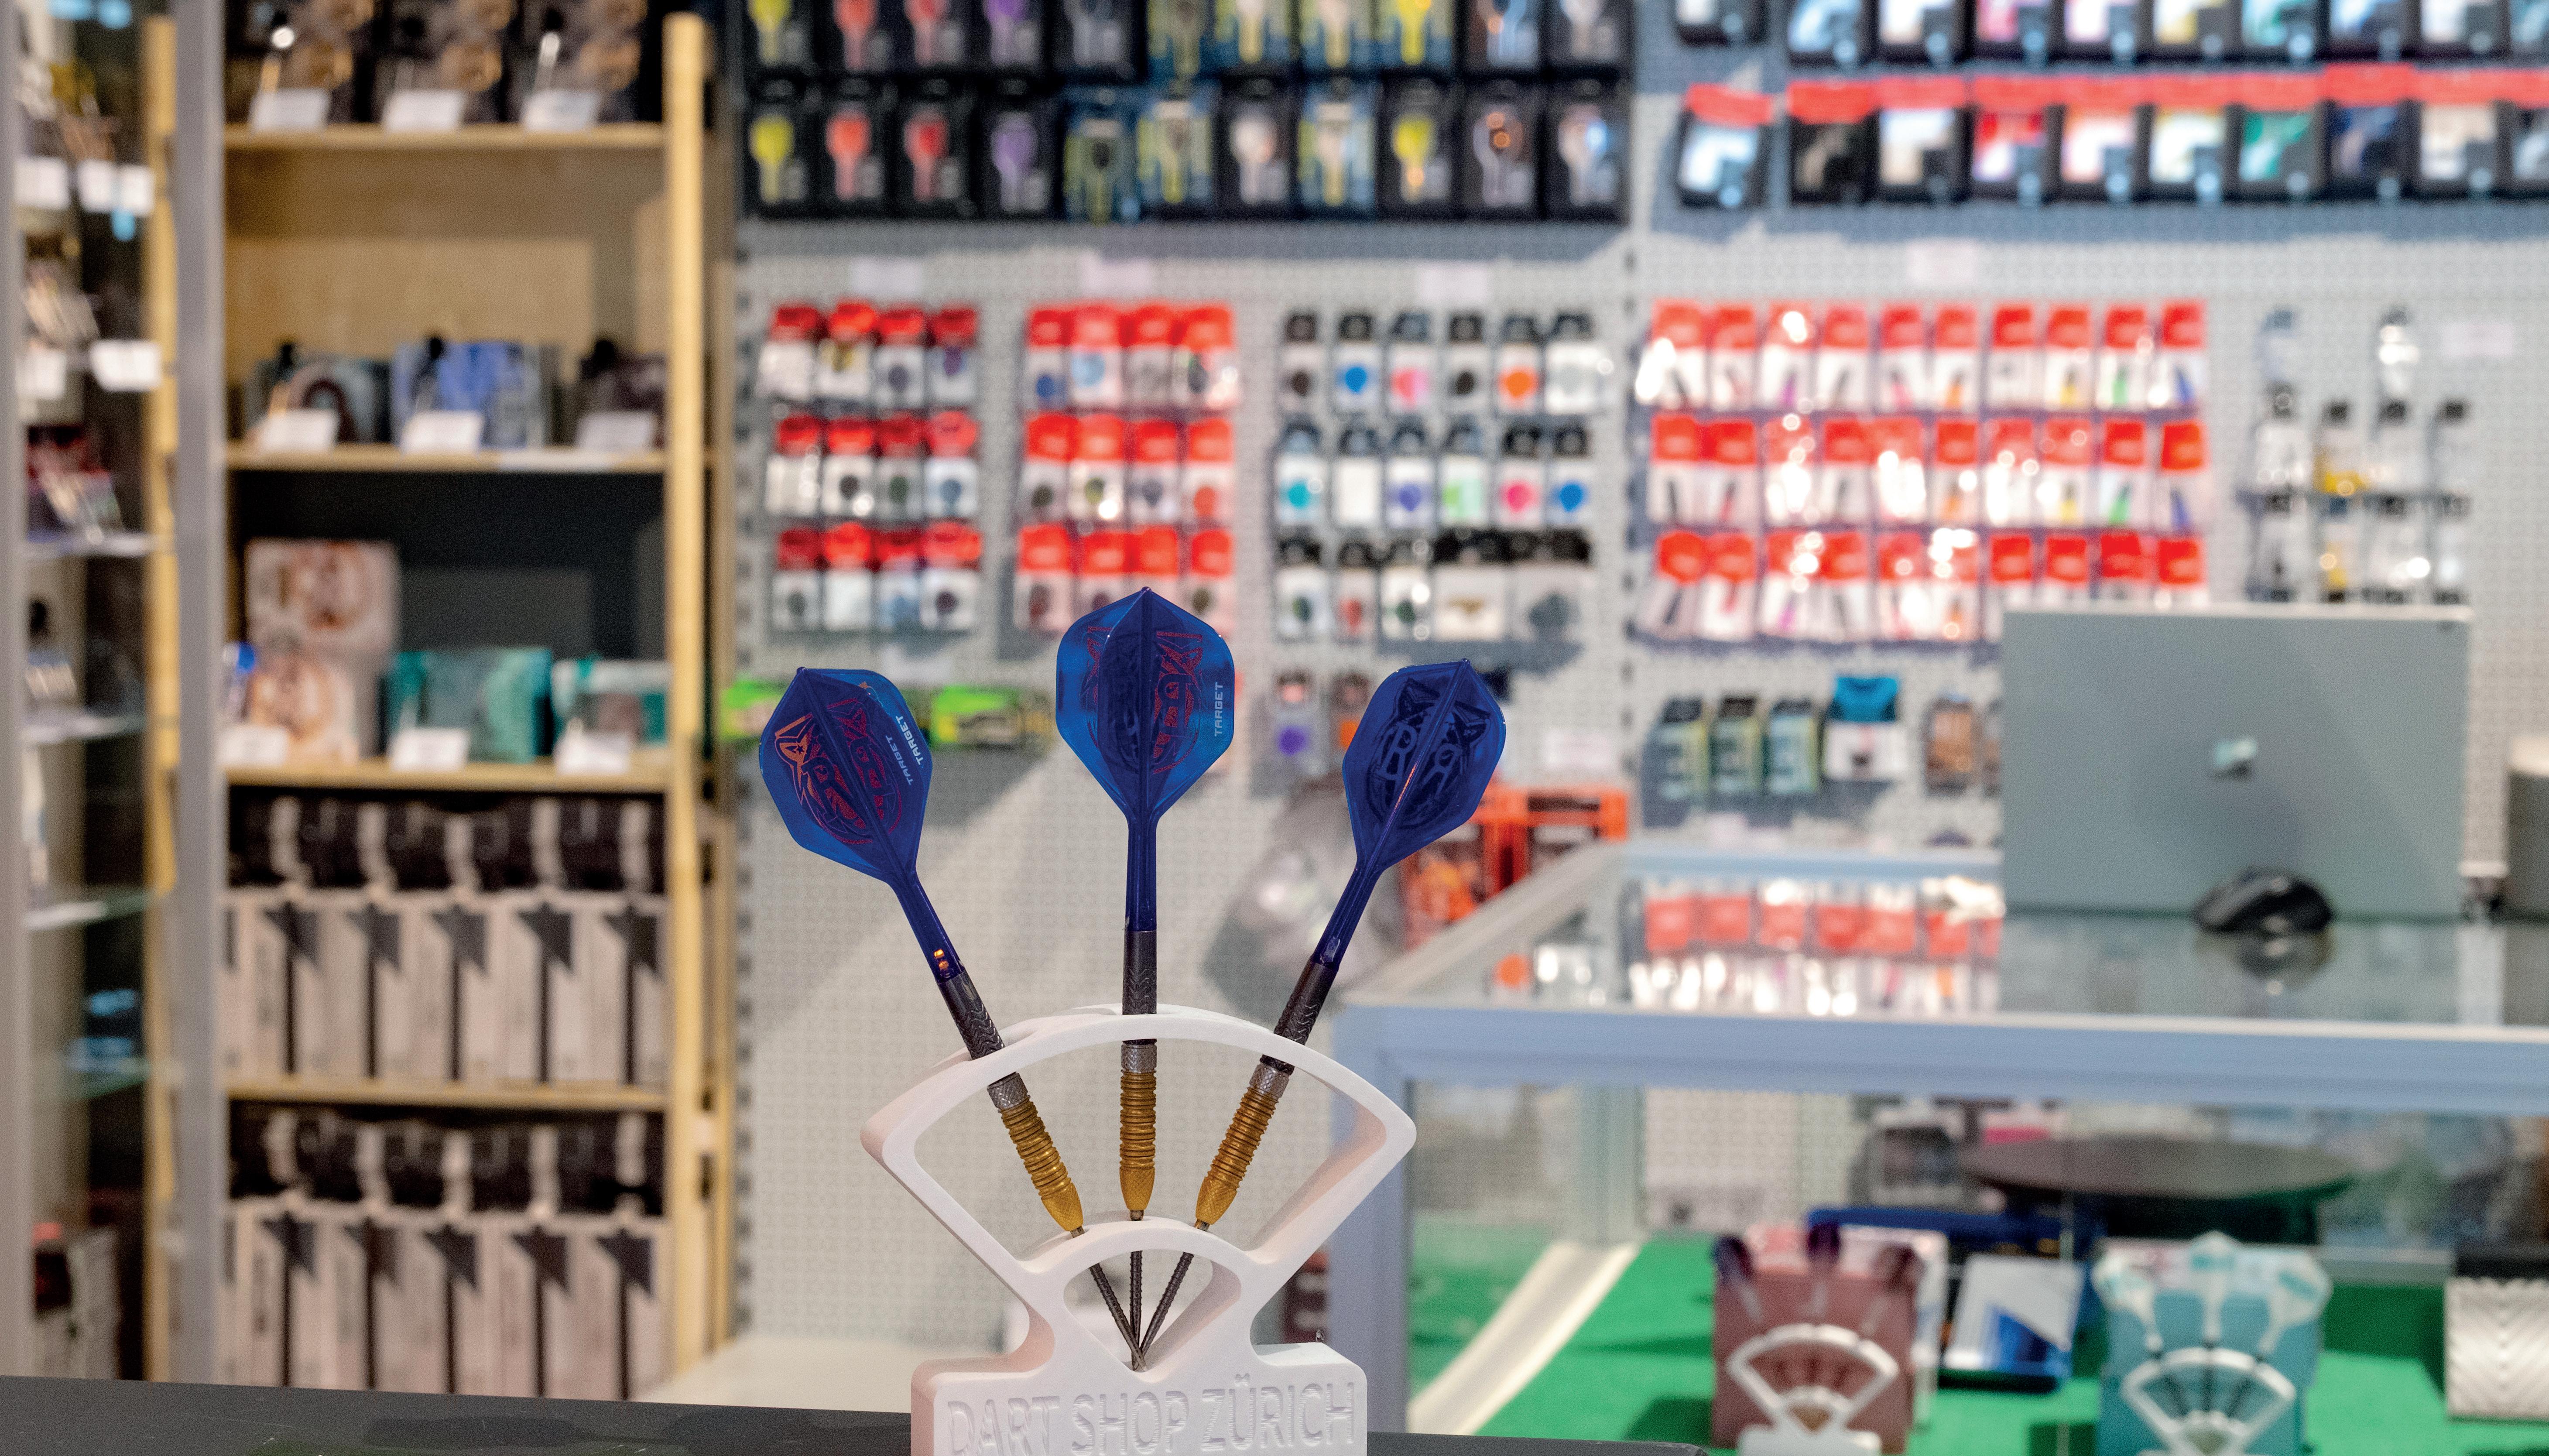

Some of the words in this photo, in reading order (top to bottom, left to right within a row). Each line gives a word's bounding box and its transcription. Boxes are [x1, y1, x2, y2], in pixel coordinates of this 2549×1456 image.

[1215, 682, 1223, 737] TARGET
[885, 736, 913, 785] TARGET
[896, 716, 924, 765] TARGET
[947, 1397, 1059, 1456] DART
[1072, 1391, 1188, 1456] SHOP
[1201, 1373, 1355, 1452] ZÜRICH
